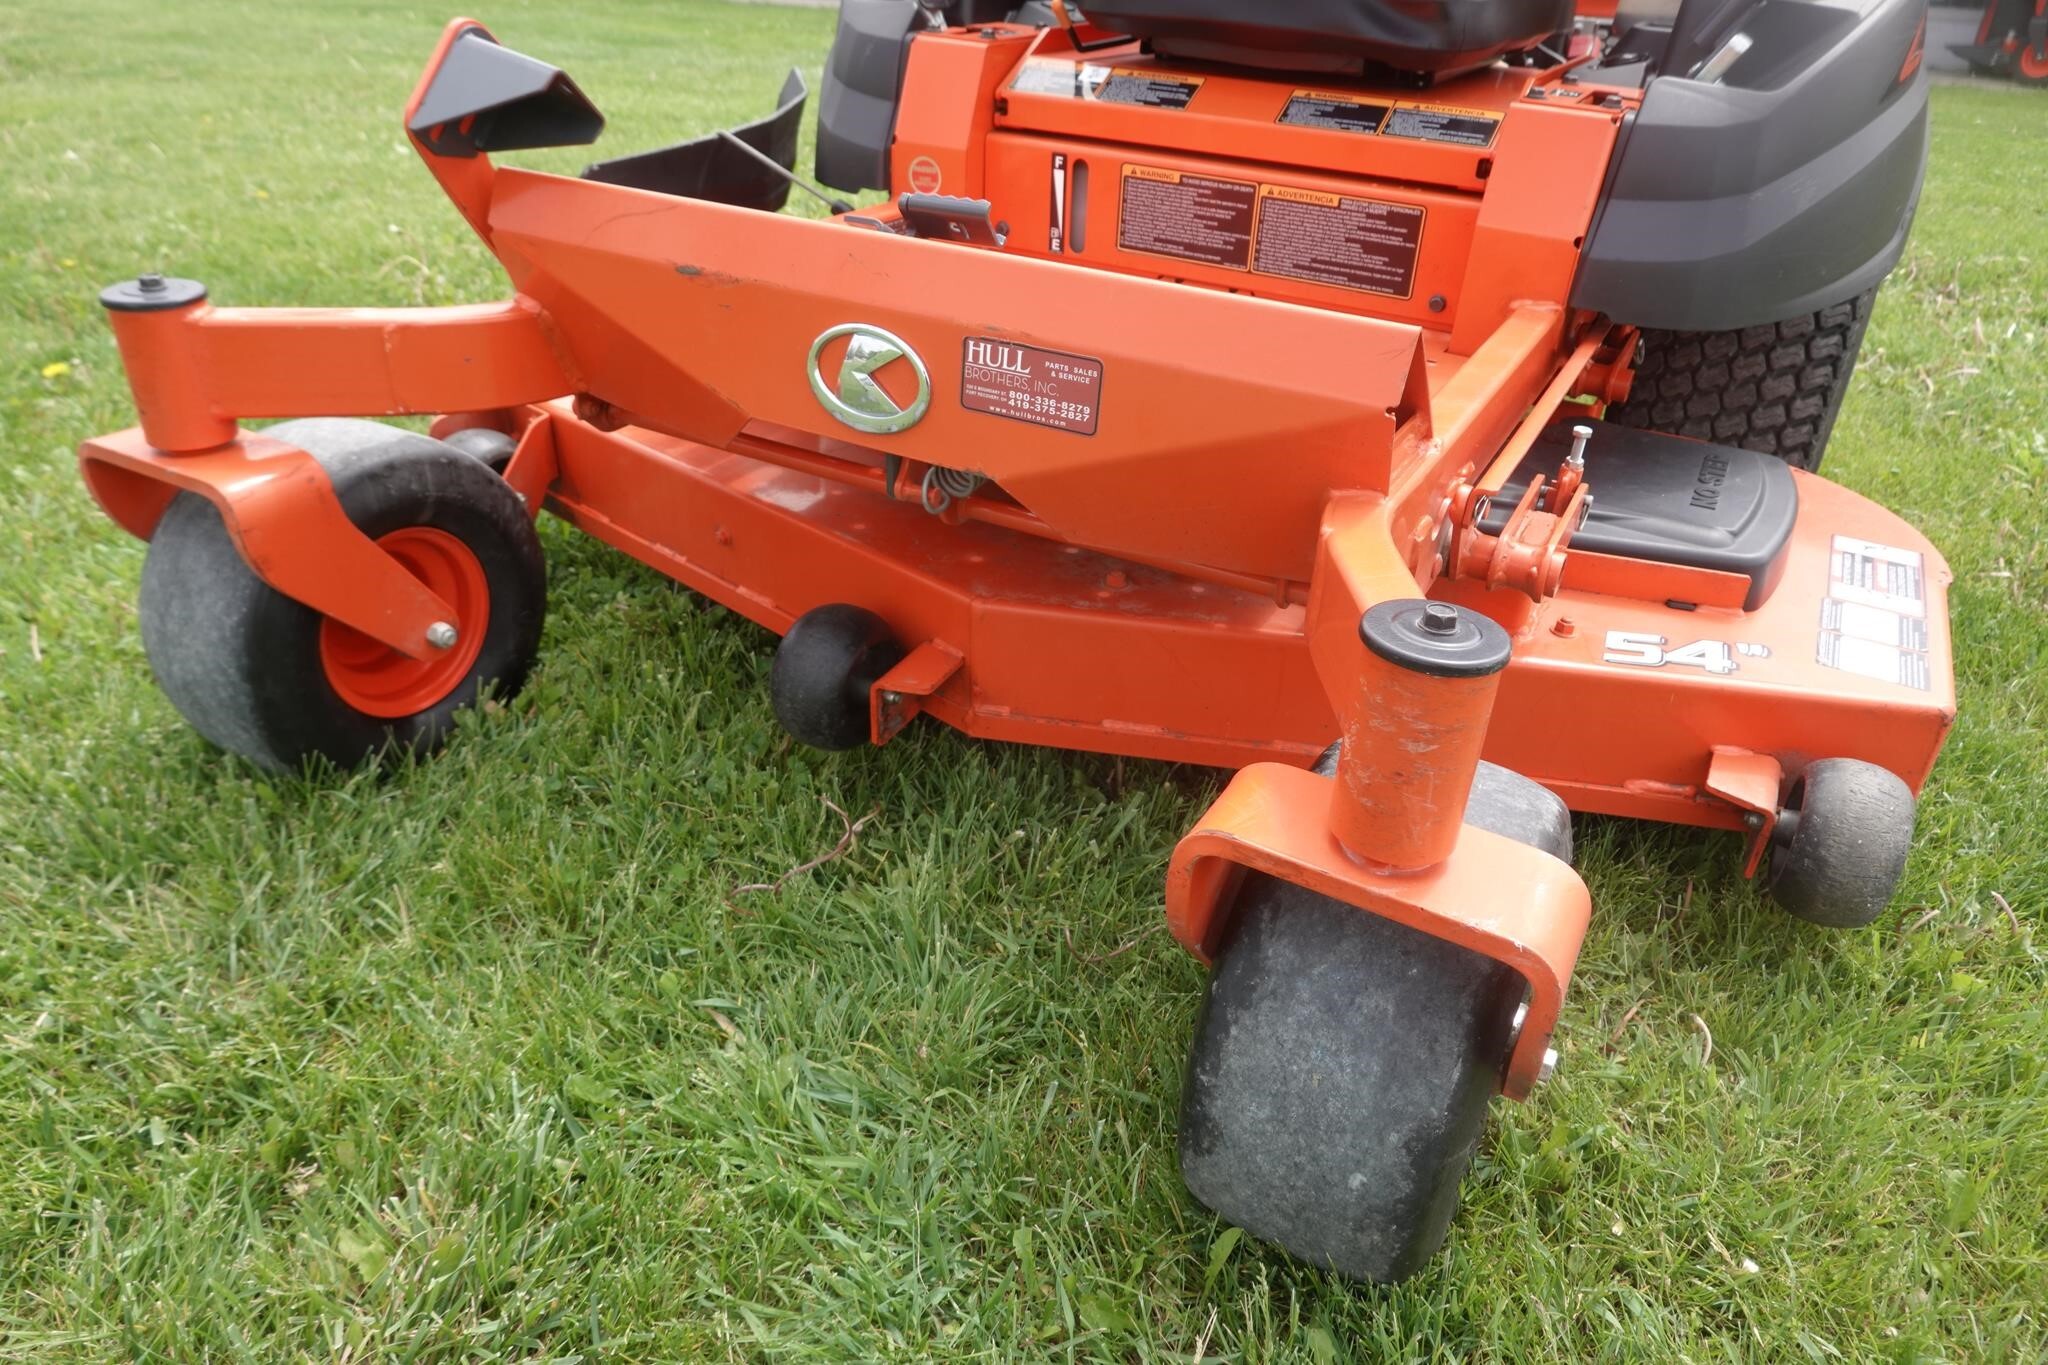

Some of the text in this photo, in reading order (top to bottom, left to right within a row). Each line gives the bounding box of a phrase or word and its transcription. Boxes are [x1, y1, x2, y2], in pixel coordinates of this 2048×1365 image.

[1424, 104, 1486, 117] ADVERTENCIA
[1054, 155, 1064, 169] F
[1140, 168, 1175, 181] WARNING
[1278, 190, 1335, 204] ADVERTENCIA
[1051, 238, 1061, 251] E
[967, 340, 1031, 373] HULL
[1045, 361, 1098, 378] PARTS SALES
[964, 366, 1060, 397] BROTHERS, INC.
[1050, 370, 1091, 384] & SERVICE
[1008, 390, 1091, 415] 800-336-8279
[1008, 398, 1090, 422] 419-375-2827
